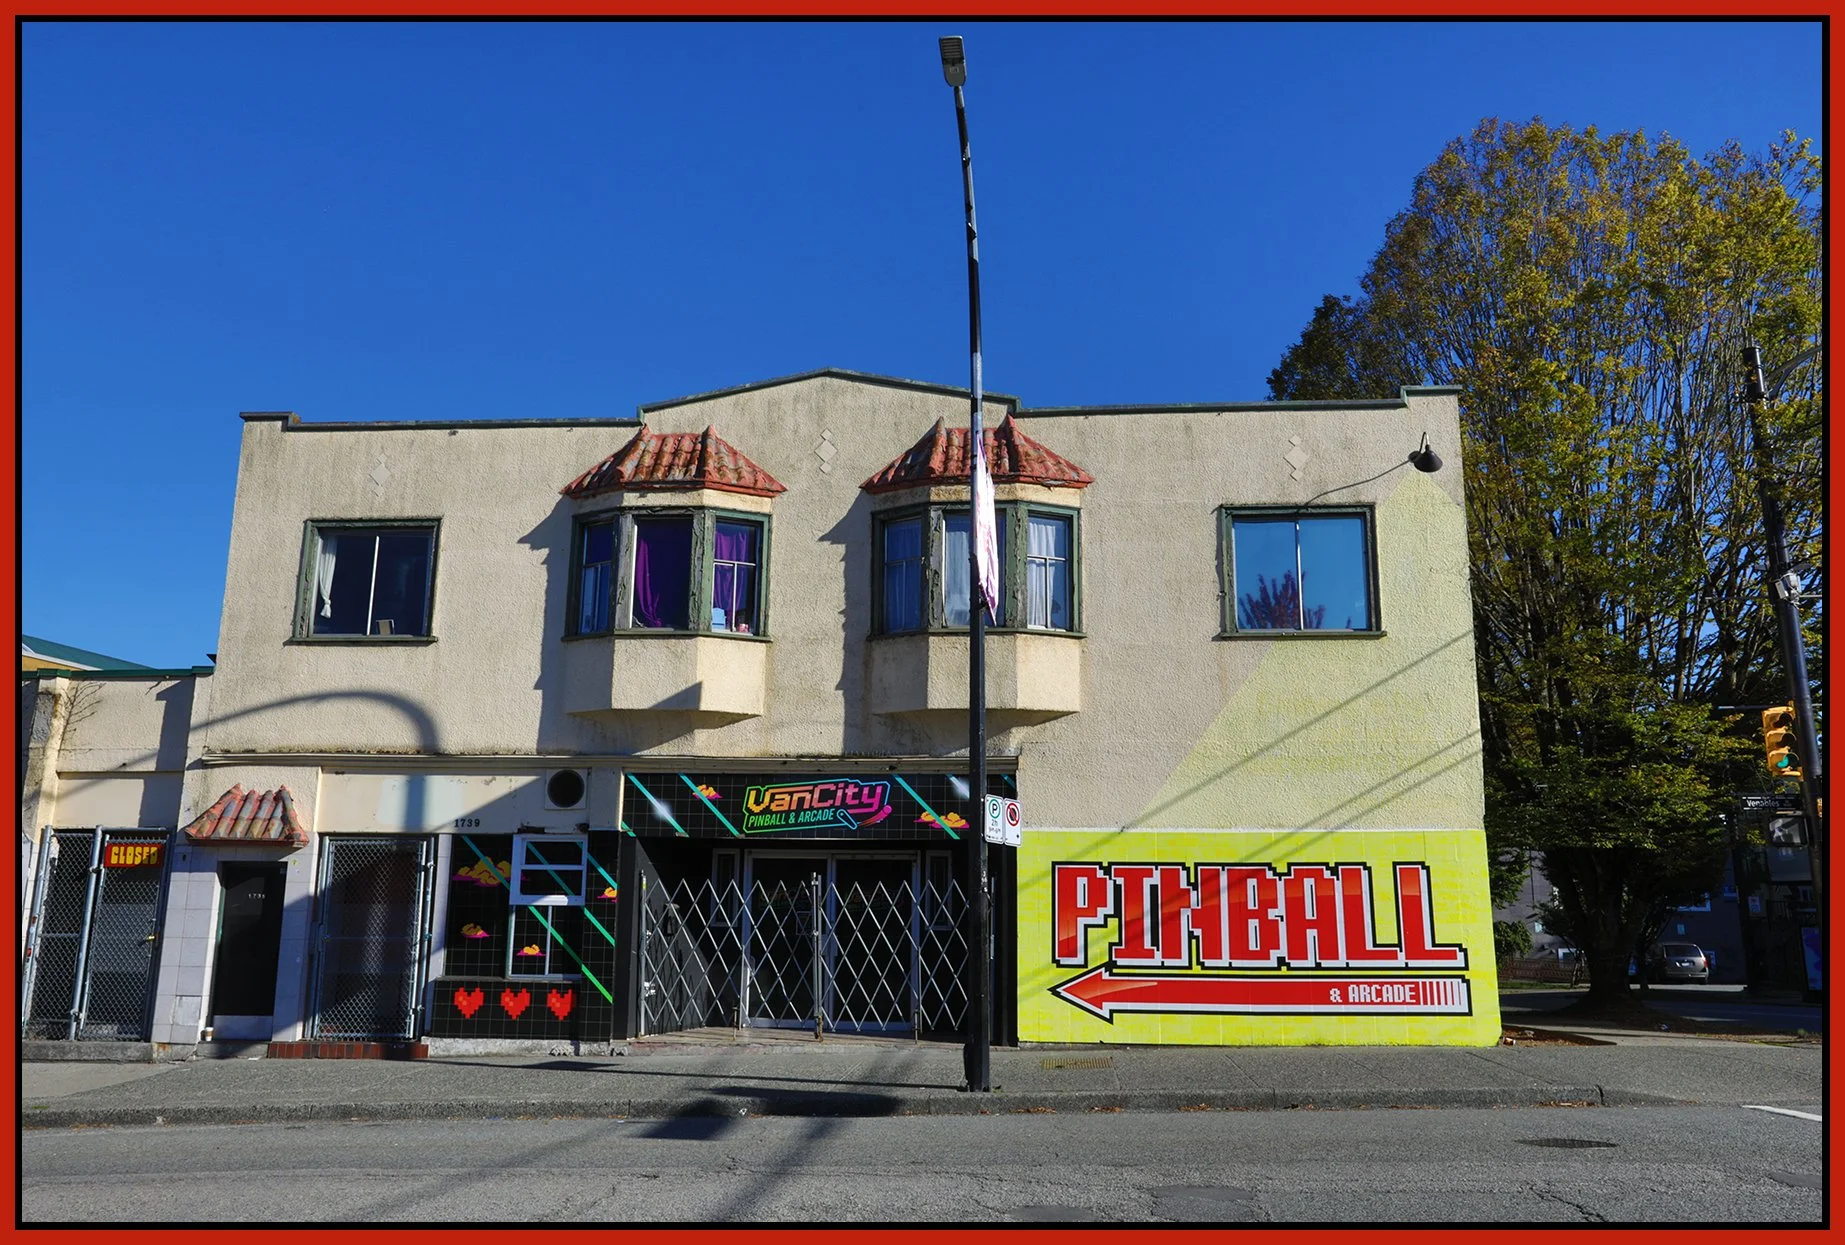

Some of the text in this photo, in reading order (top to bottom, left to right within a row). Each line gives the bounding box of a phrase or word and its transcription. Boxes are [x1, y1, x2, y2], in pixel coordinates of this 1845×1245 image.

[747, 782, 883, 814] VanCity
[748, 808, 836, 828] PINBALL & ARCADE
[991, 803, 998, 814] P
[454, 818, 481, 828] 1739
[110, 846, 158, 865] CLOSED
[1053, 863, 1467, 969] PINBALL
[1329, 984, 1416, 1003] & ARCADE
